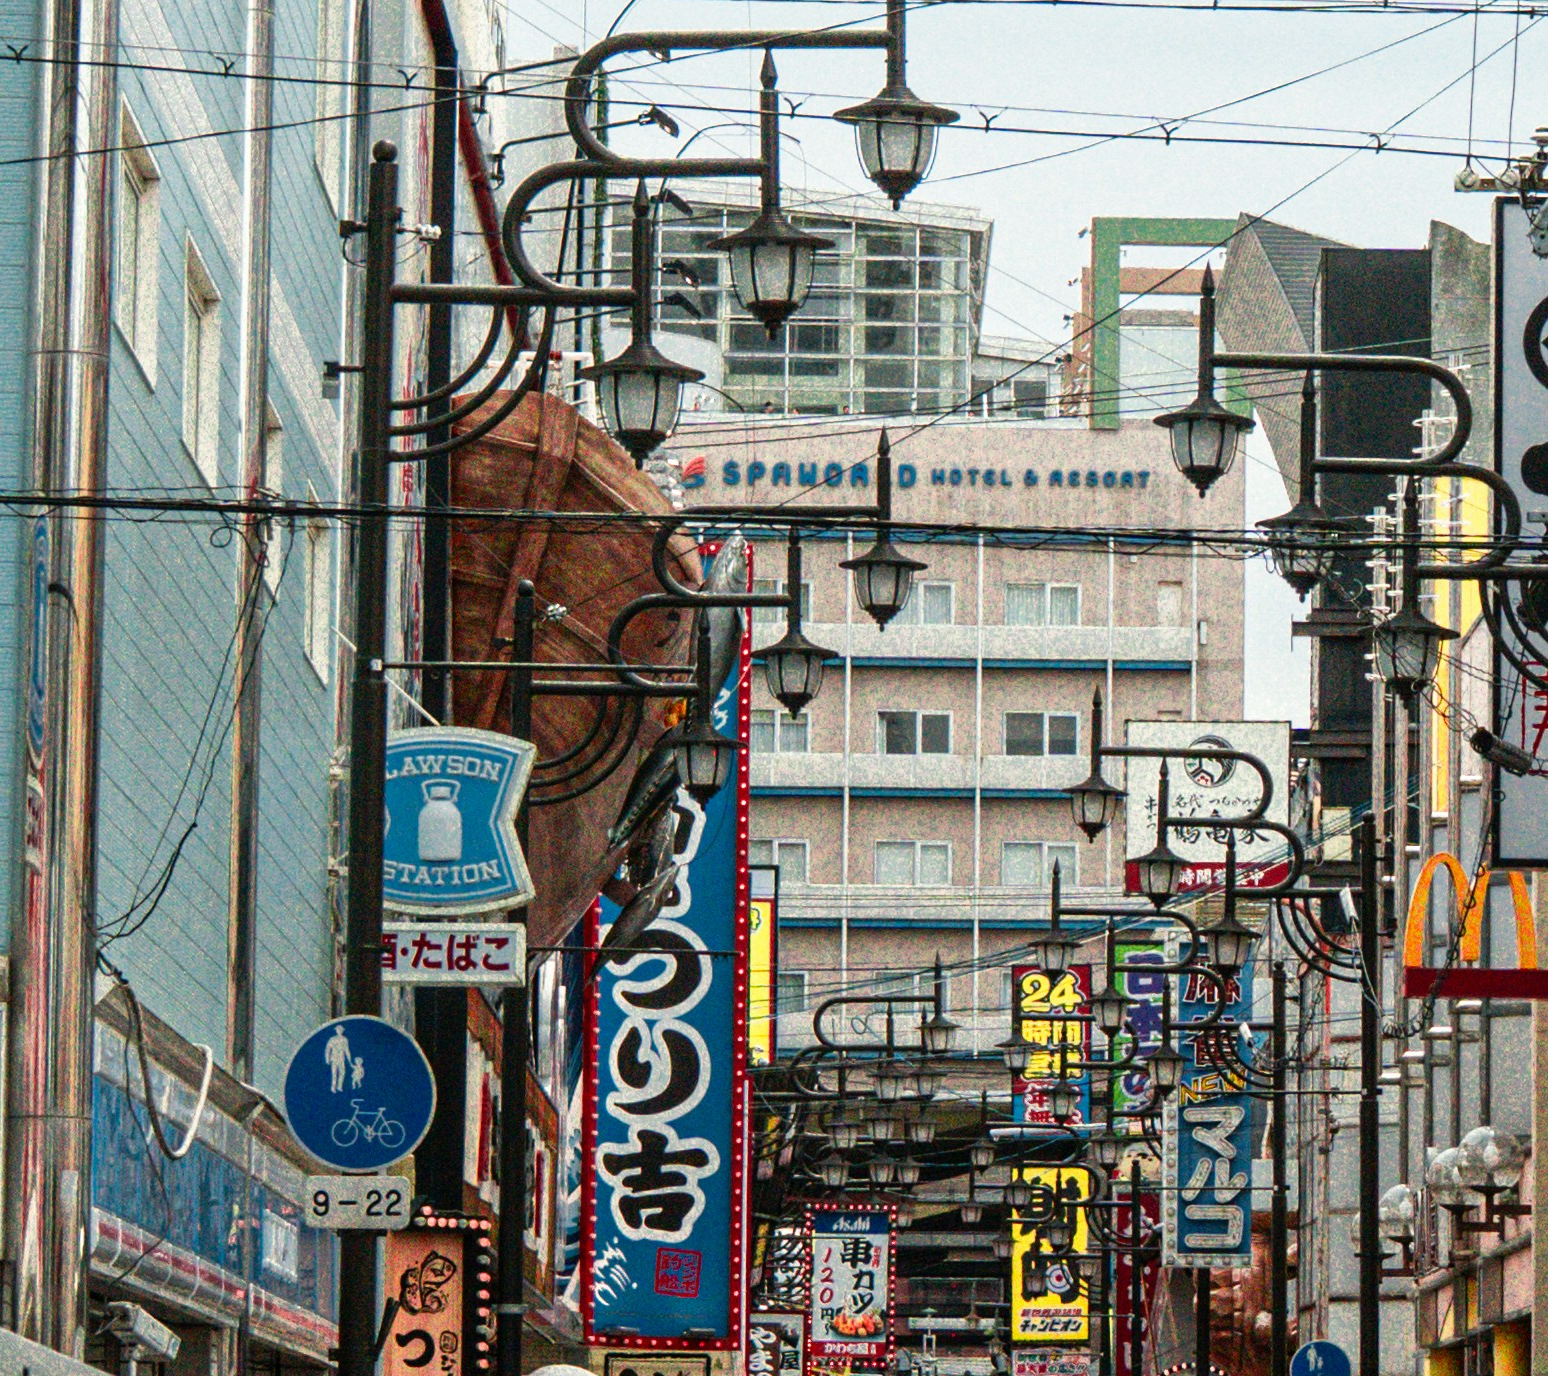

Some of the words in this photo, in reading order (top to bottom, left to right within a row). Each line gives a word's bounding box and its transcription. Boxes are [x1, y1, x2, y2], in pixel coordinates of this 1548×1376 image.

[723, 461, 918, 489] SPAWORD
[931, 469, 1013, 489] HOTEL
[1048, 469, 1151, 489] RESORT
[386, 755, 502, 782] LAWSON
[384, 859, 500, 886] STATION
[1021, 974, 1083, 1013] 24
[1180, 1070, 1248, 1107] NEW
[1181, 1105, 1249, 1249] マルコ
[840, 1238, 876, 1314] 串カツ
